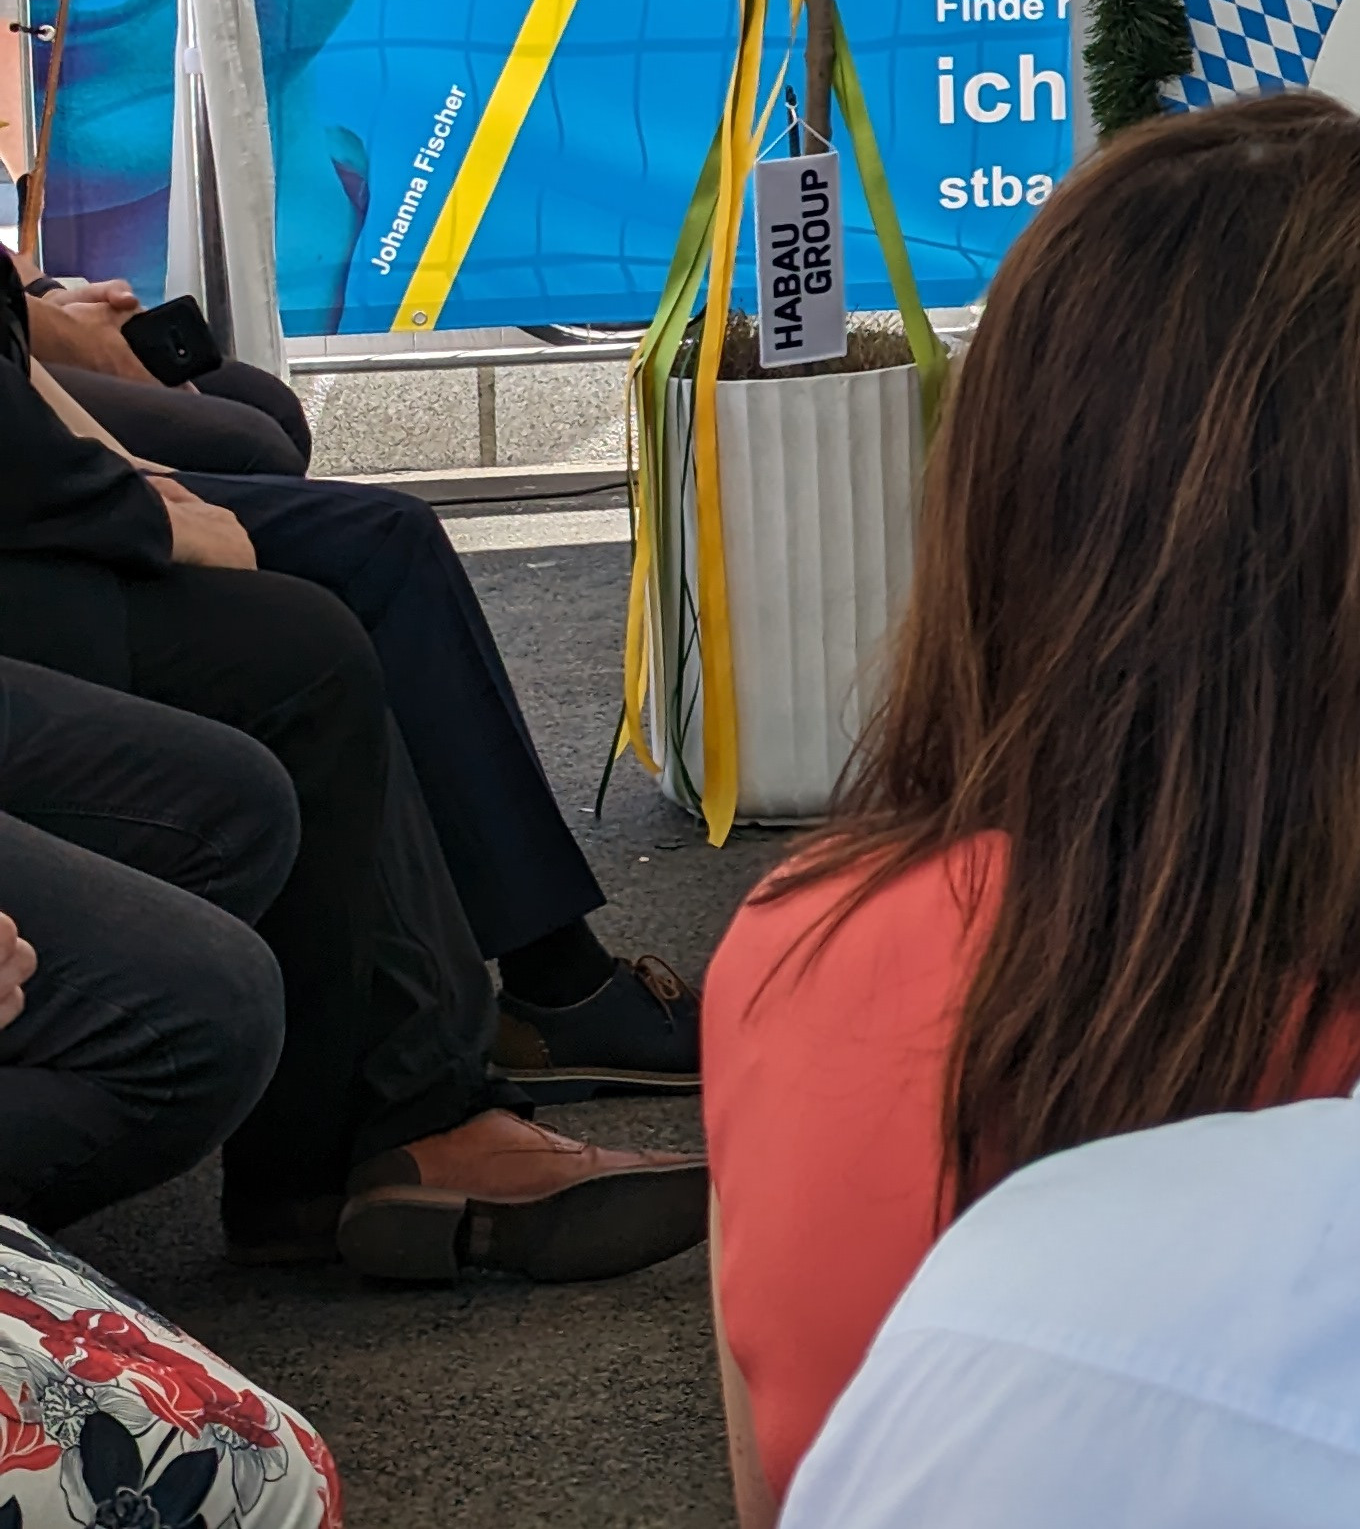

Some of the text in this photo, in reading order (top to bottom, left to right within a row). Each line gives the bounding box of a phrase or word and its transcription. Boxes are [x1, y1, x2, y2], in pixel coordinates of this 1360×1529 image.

[938, 53, 1067, 125] ich
[371, 83, 467, 276] Johanna Fischer
[801, 168, 833, 295] GROUP
[938, 165, 1054, 210] stba
[771, 222, 804, 351] HABAU
